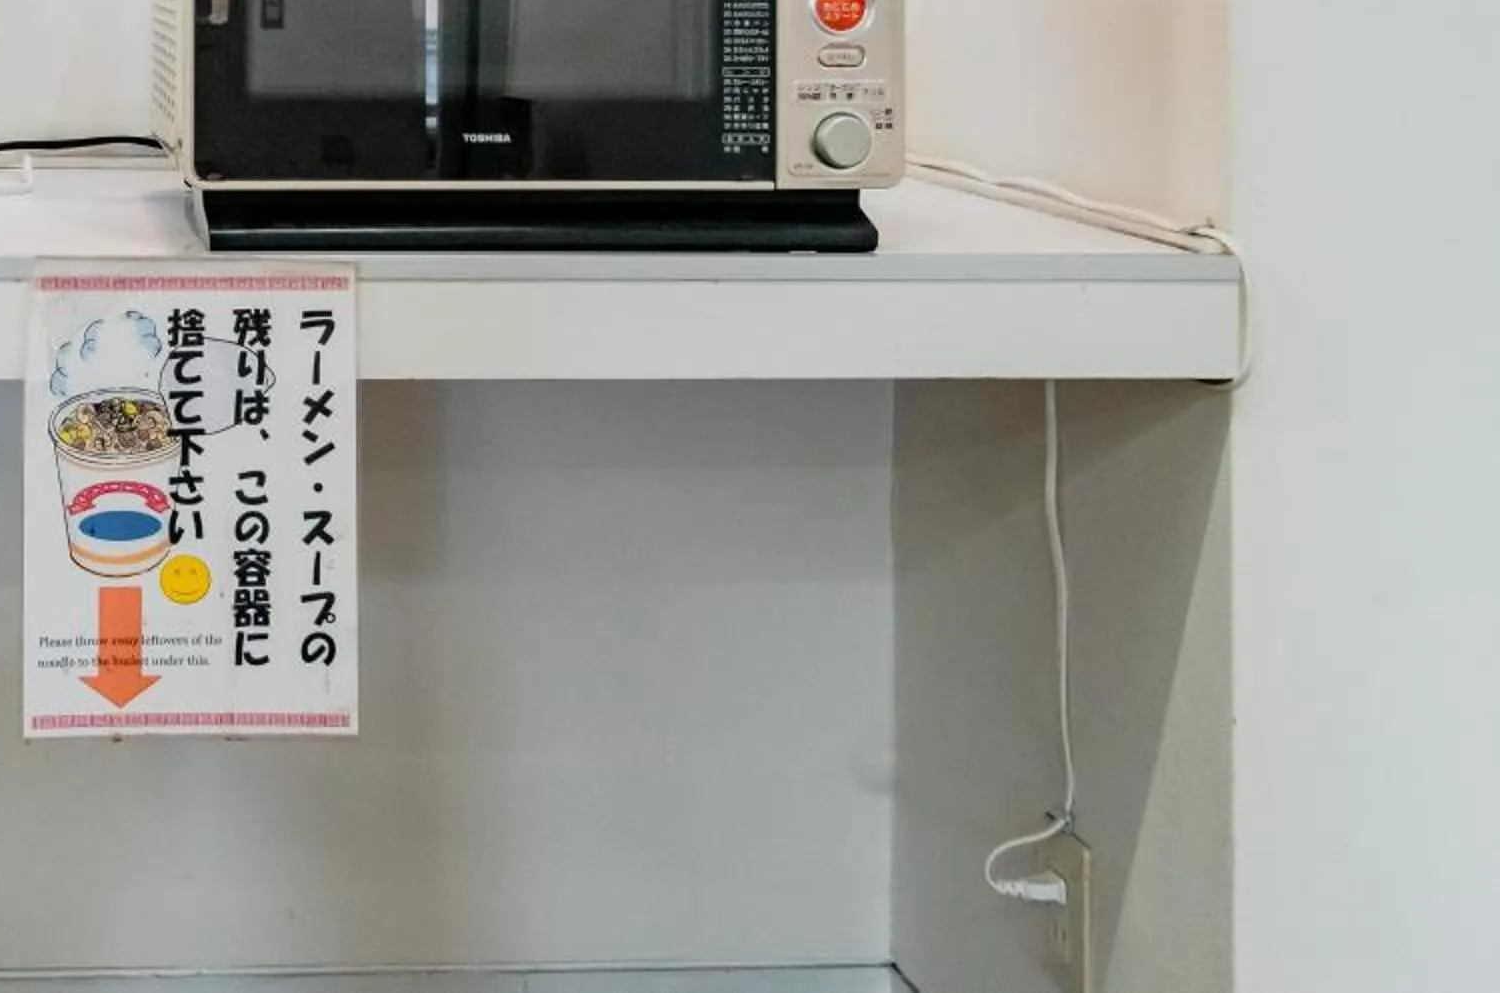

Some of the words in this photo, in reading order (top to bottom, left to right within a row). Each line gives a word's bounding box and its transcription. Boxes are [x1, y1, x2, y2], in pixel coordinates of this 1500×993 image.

[462, 133, 512, 143] TOSHIBA
[167, 308, 206, 545] 捨てて下さい
[233, 308, 273, 667] 残りは、この容器に
[300, 310, 338, 667] ラーメン・スープの
[39, 636, 72, 648] Please
[75, 636, 108, 647] throw
[141, 634, 189, 647] leftovers
[191, 634, 204, 646] of
[205, 634, 223, 646] the
[77, 657, 90, 667] to
[91, 655, 108, 667] the
[151, 655, 184, 667] under
